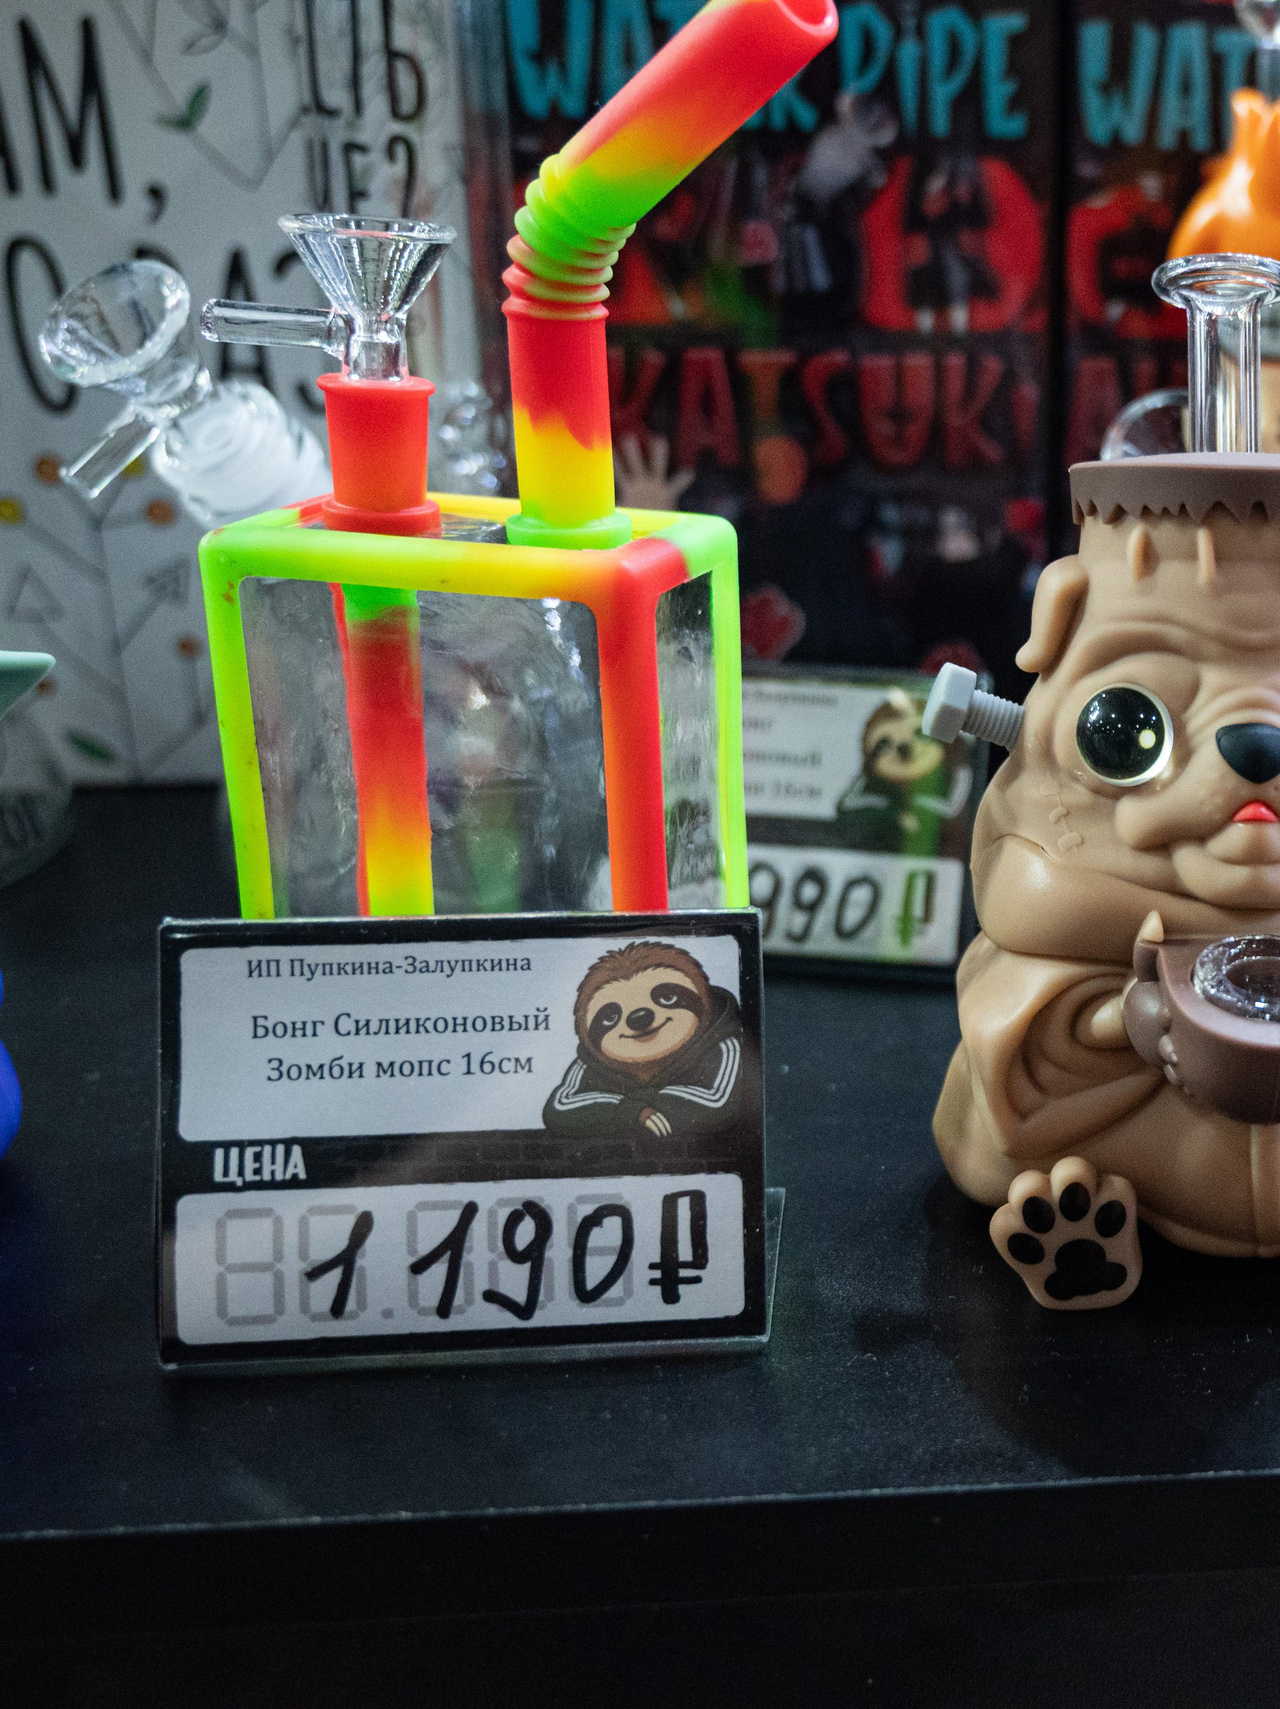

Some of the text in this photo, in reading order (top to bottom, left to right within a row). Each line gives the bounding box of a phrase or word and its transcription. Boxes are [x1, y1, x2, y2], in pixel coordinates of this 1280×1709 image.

[246, 955, 533, 982] ИП Пупкина-Залупкина
[250, 1007, 552, 1039] Бонг Силиконовый
[266, 1050, 535, 1082] Зомби мопс 16см
[212, 1144, 308, 1186] ЦЕНА
